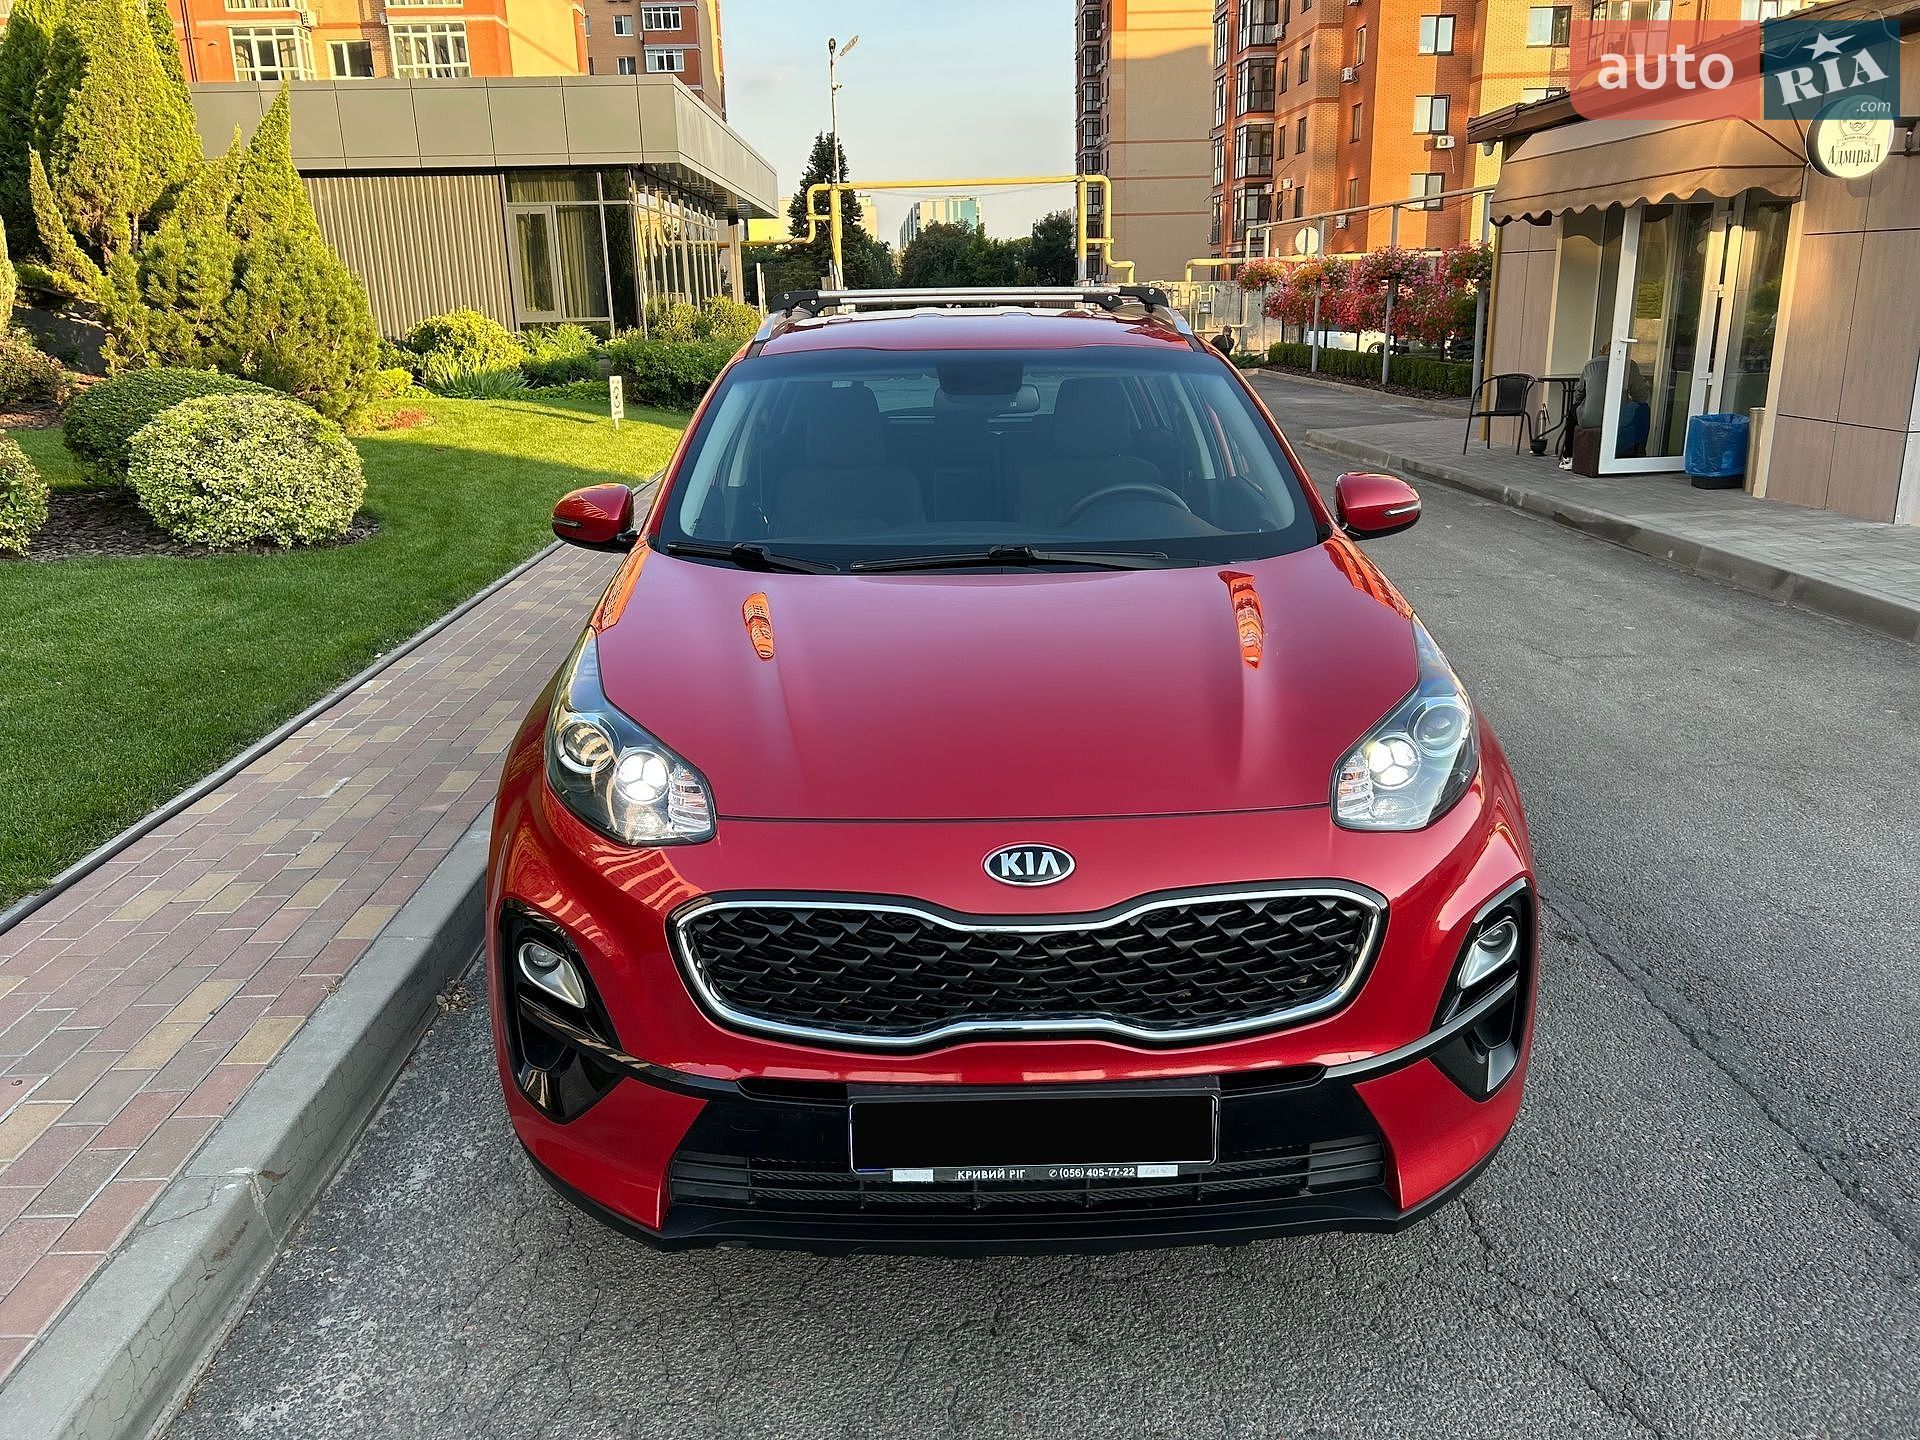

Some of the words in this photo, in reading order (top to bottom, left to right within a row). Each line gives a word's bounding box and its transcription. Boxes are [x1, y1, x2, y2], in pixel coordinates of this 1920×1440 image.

[1000, 851, 1061, 877] KIA
[957, 1168, 1006, 1180] КРИВИЙ
[1009, 1169, 1026, 1179] РІГ
[1059, 1167, 1085, 1178] (056)
[1086, 1167, 1136, 1178] 405-77-22
